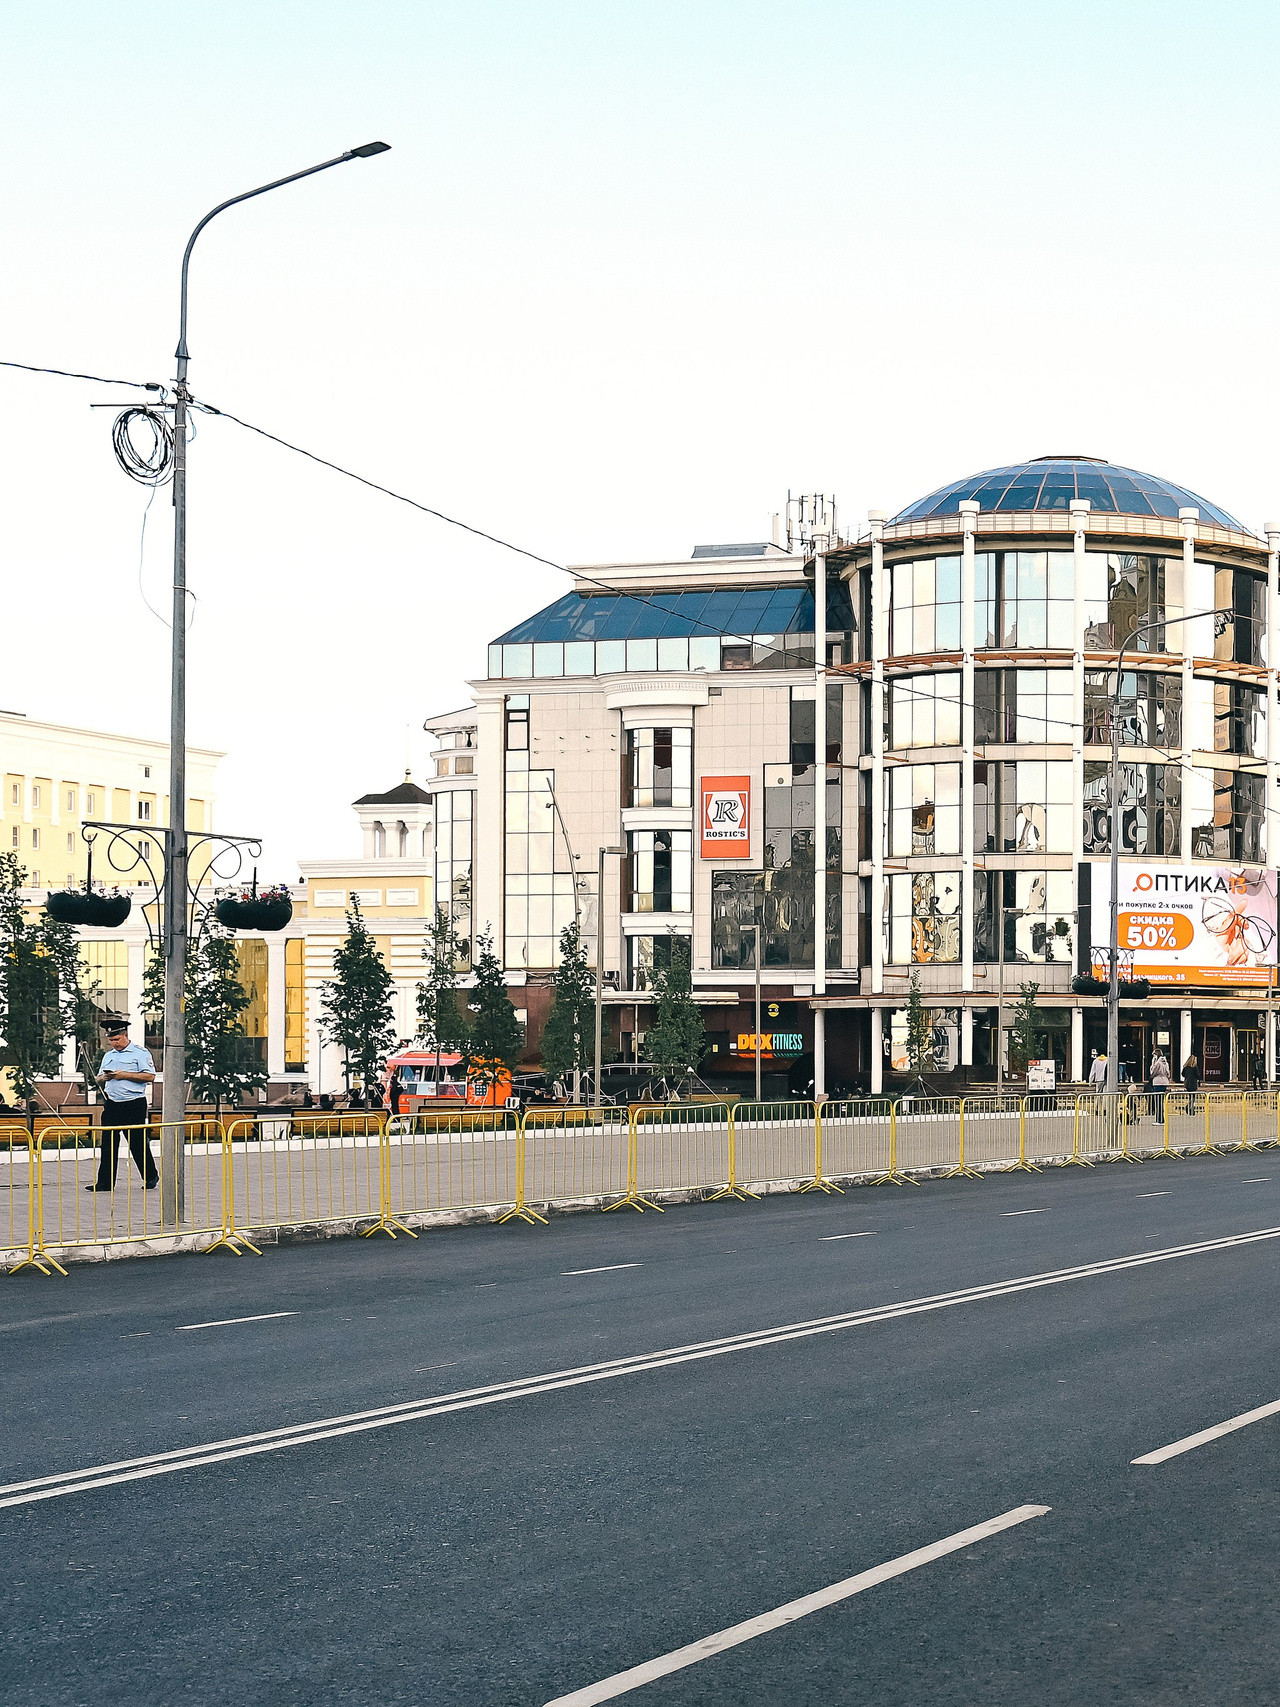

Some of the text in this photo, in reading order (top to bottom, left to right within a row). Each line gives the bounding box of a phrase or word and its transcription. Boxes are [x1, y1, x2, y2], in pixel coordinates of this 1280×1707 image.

[705, 830, 746, 838] ROSTIC'S
[1129, 915, 1175, 926] скидка
[1127, 926, 1177, 947] 50%
[772, 1033, 803, 1050] FITNESS
